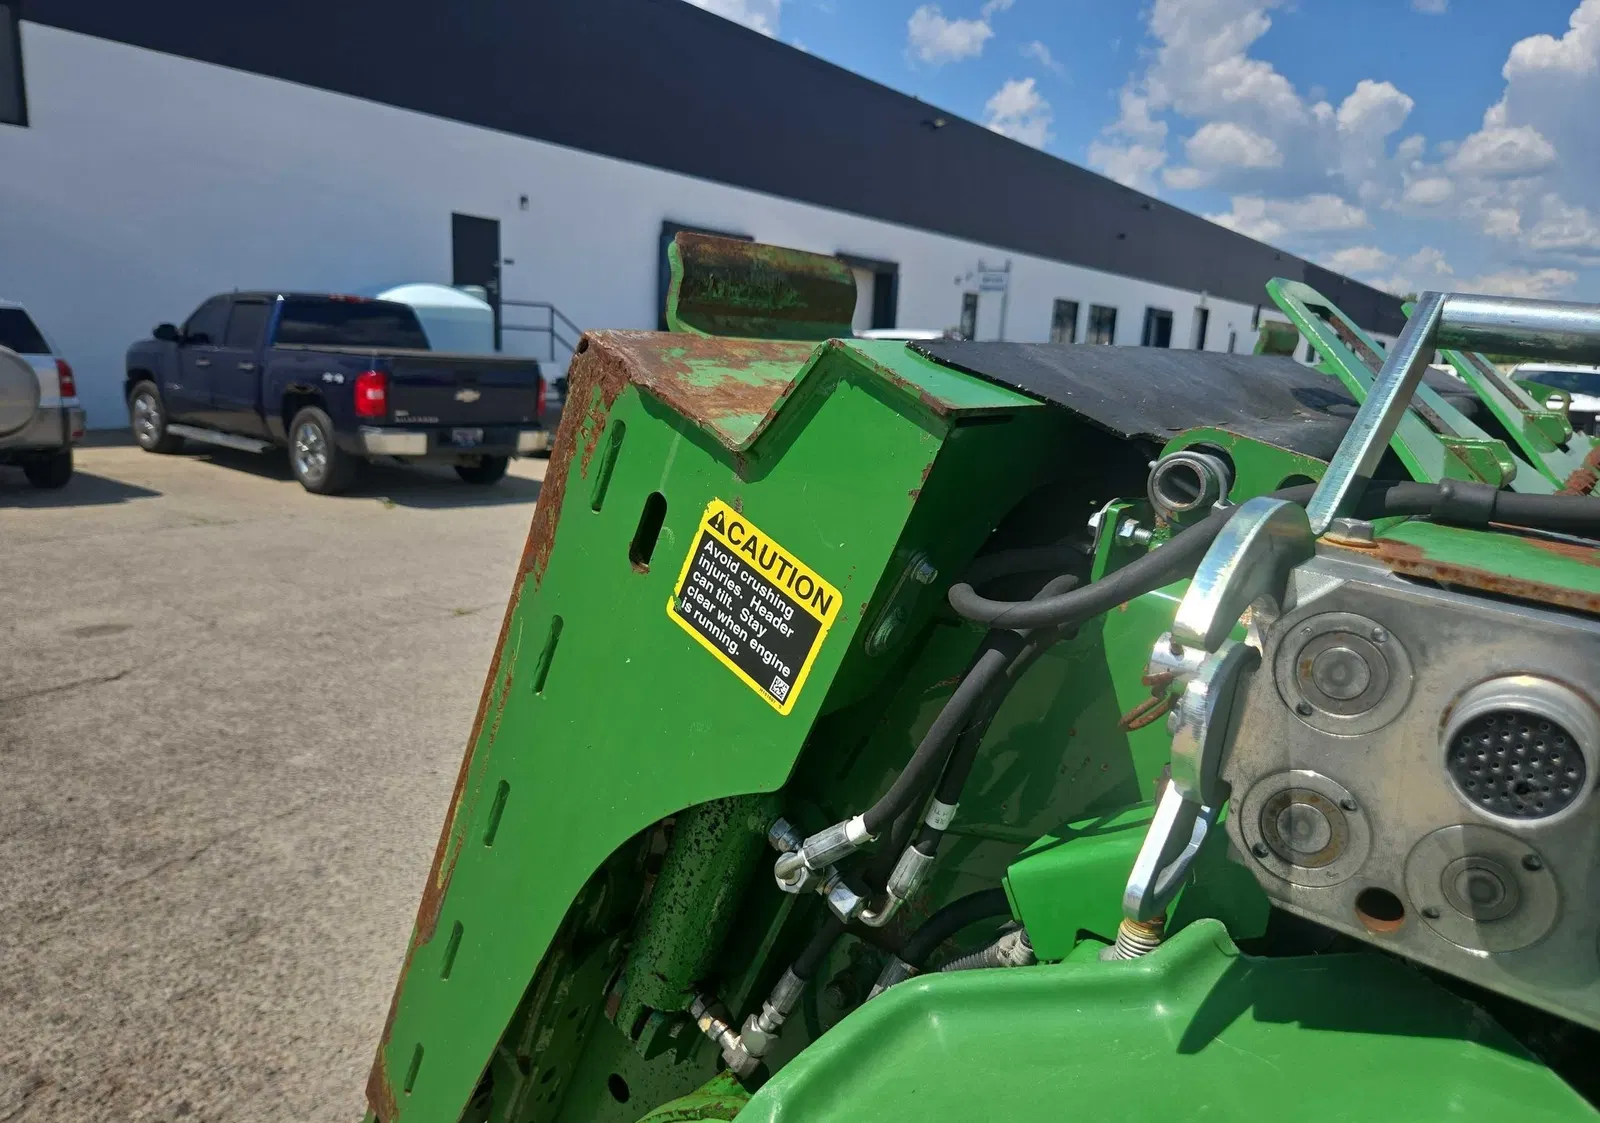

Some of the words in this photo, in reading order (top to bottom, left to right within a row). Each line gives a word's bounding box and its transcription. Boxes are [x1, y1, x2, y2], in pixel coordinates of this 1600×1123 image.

[693, 571, 714, 593] can
[715, 588, 733, 611] tilt.
[740, 607, 767, 638] Stay
[699, 553, 743, 599] injuries.
[749, 595, 794, 638] Header
[704, 540, 740, 574] Avoid
[740, 570, 794, 620] crushing
[727, 521, 834, 617] CAUTION
[681, 596, 692, 613] is
[693, 610, 739, 656] running.
[687, 586, 716, 613] clear
[717, 609, 748, 642] when
[749, 638, 791, 678] engine
